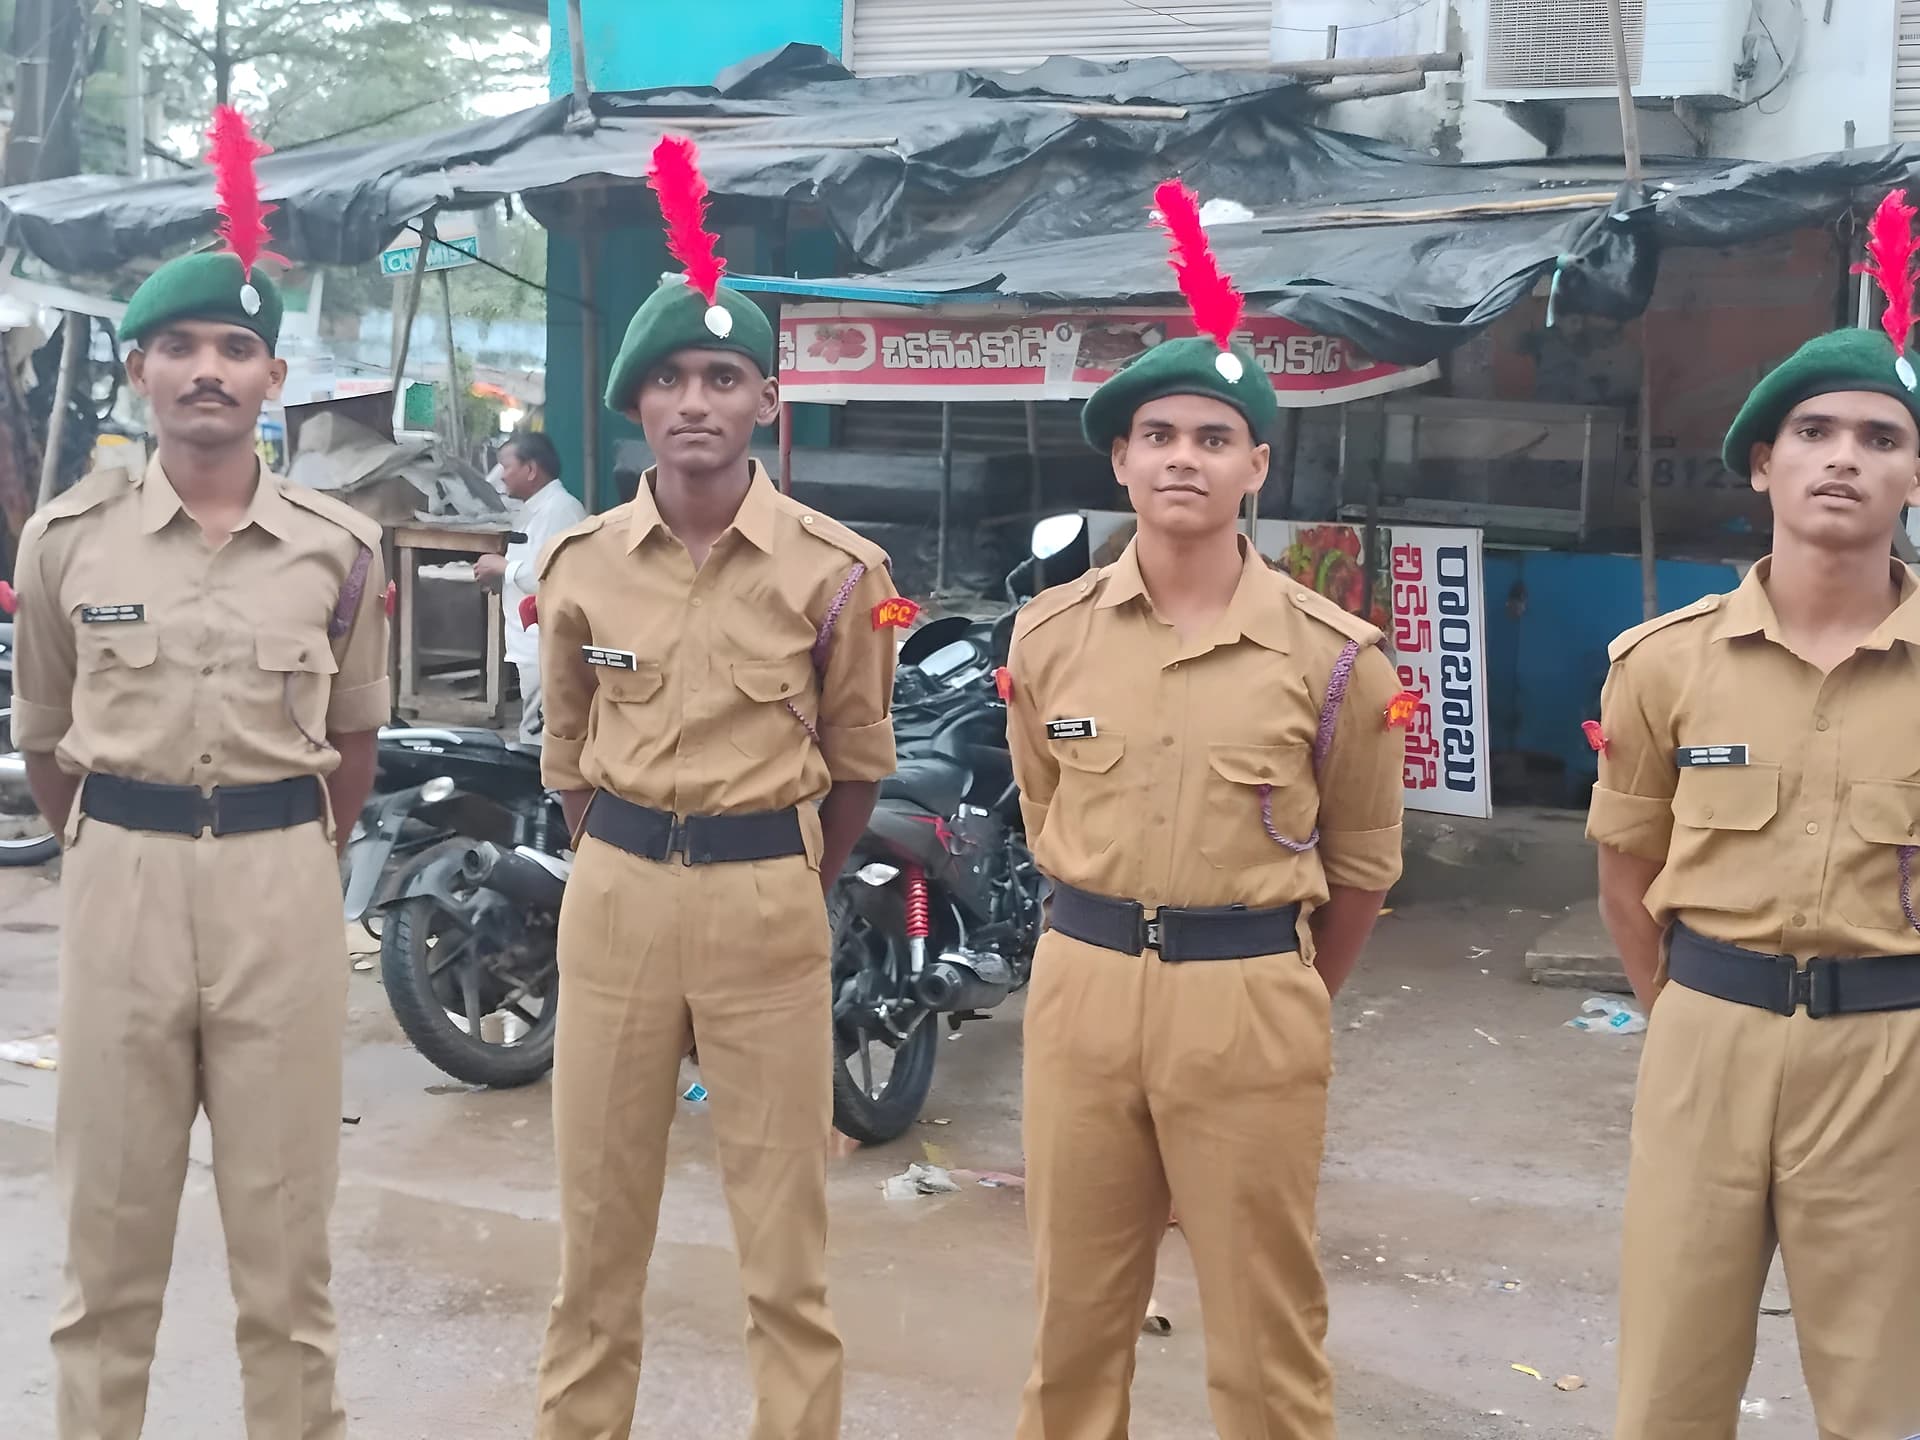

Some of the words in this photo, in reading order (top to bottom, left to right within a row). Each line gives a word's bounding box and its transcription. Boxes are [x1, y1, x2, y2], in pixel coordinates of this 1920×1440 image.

[879, 603, 911, 625] NCC
[1391, 542, 1432, 653] చికెన్
[1437, 545, 1476, 793] రాంబాబు
